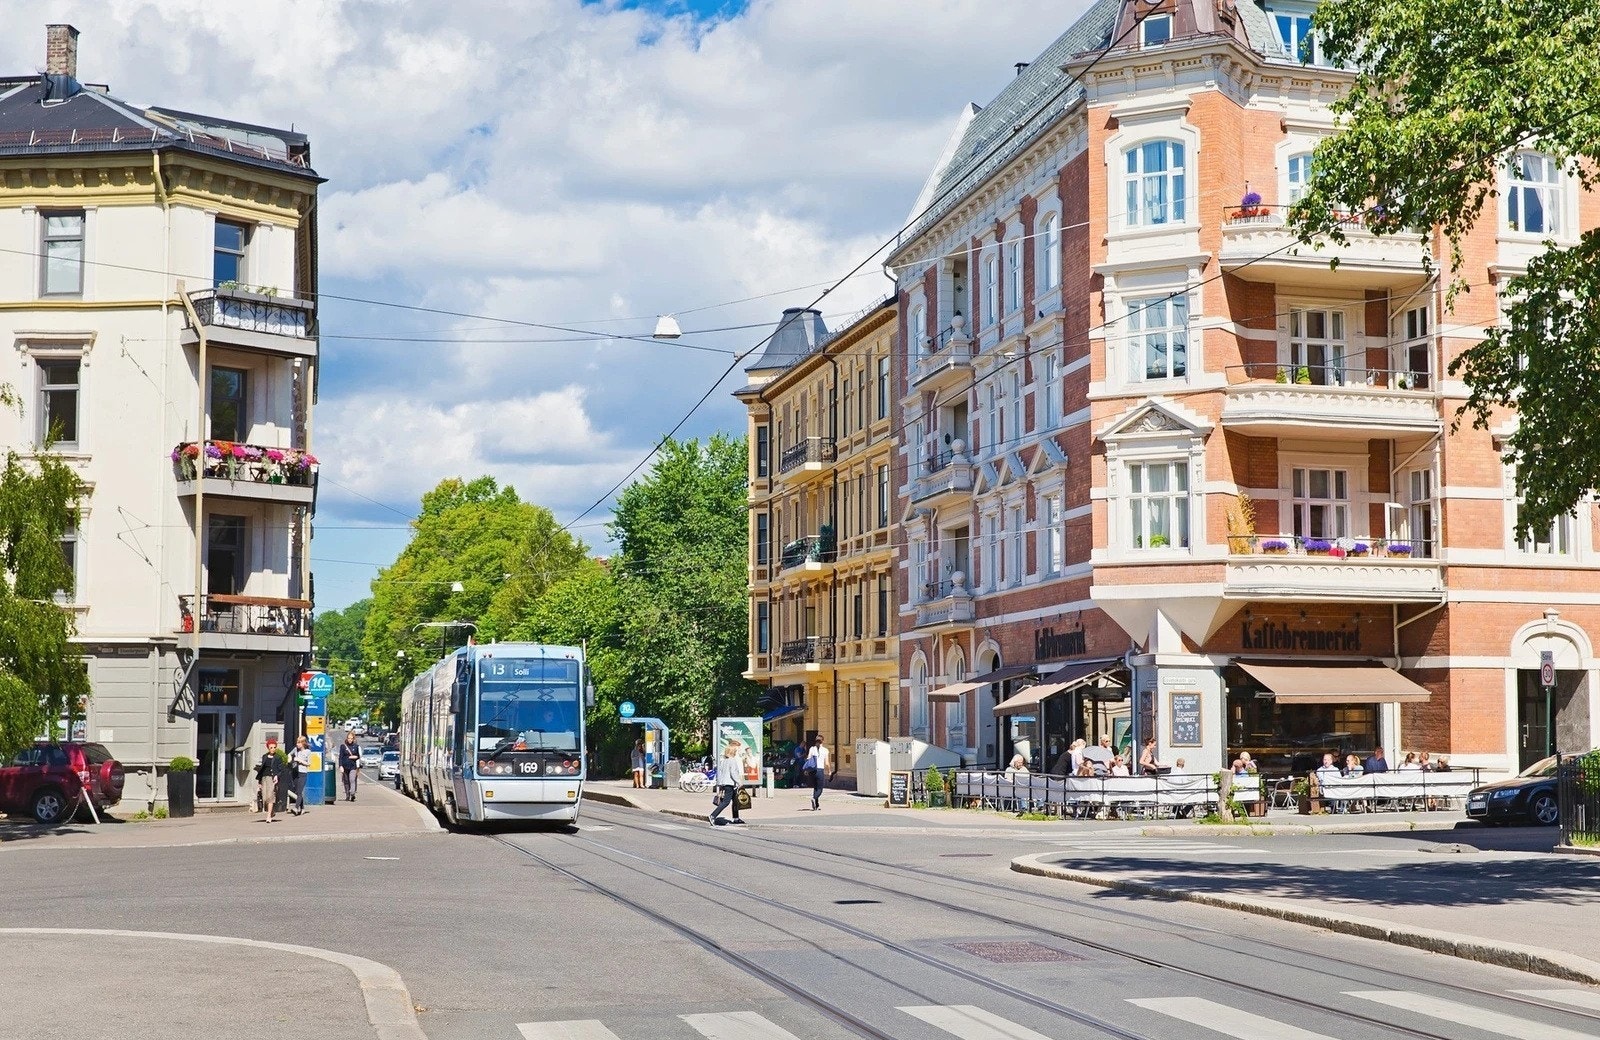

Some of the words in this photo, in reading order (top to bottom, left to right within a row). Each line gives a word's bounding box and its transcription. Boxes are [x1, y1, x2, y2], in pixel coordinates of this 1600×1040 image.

[1242, 621, 1361, 650] Kaffebrenneriet
[492, 664, 505, 675] 13
[514, 668, 530, 676] Solli
[312, 677, 326, 688] 10
[519, 762, 538, 774] 169
